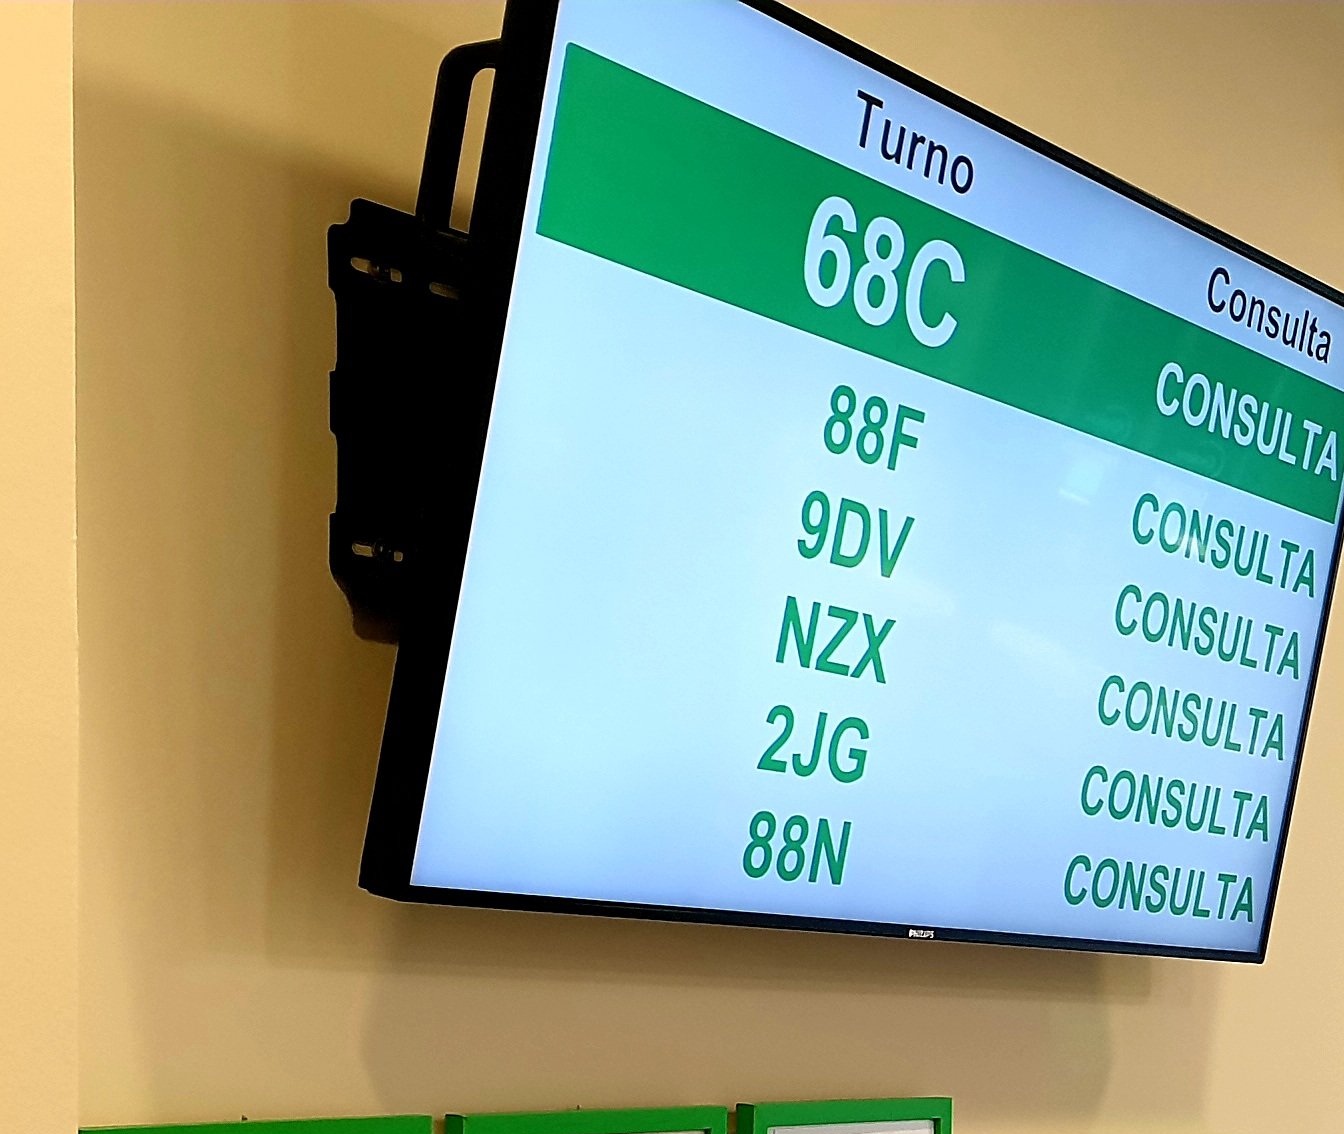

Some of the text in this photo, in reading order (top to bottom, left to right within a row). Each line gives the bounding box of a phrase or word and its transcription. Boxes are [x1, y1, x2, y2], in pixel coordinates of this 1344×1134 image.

[855, 89, 975, 195] Turno
[804, 196, 965, 348] 68C
[1206, 266, 1331, 365] Consulta
[823, 384, 925, 472] 88F
[1156, 361, 1338, 480] CONSULTA
[798, 490, 914, 578] 9DV
[1133, 492, 1316, 598] CONSULTA
[777, 595, 896, 685] NZX
[1114, 584, 1300, 680] CONSULTA
[757, 704, 869, 783] 2JG
[1097, 674, 1285, 761] CONSULTA
[743, 812, 849, 885] 88N
[1079, 765, 1268, 843] CONSULTA
[1063, 854, 1254, 924] CONSULTA
